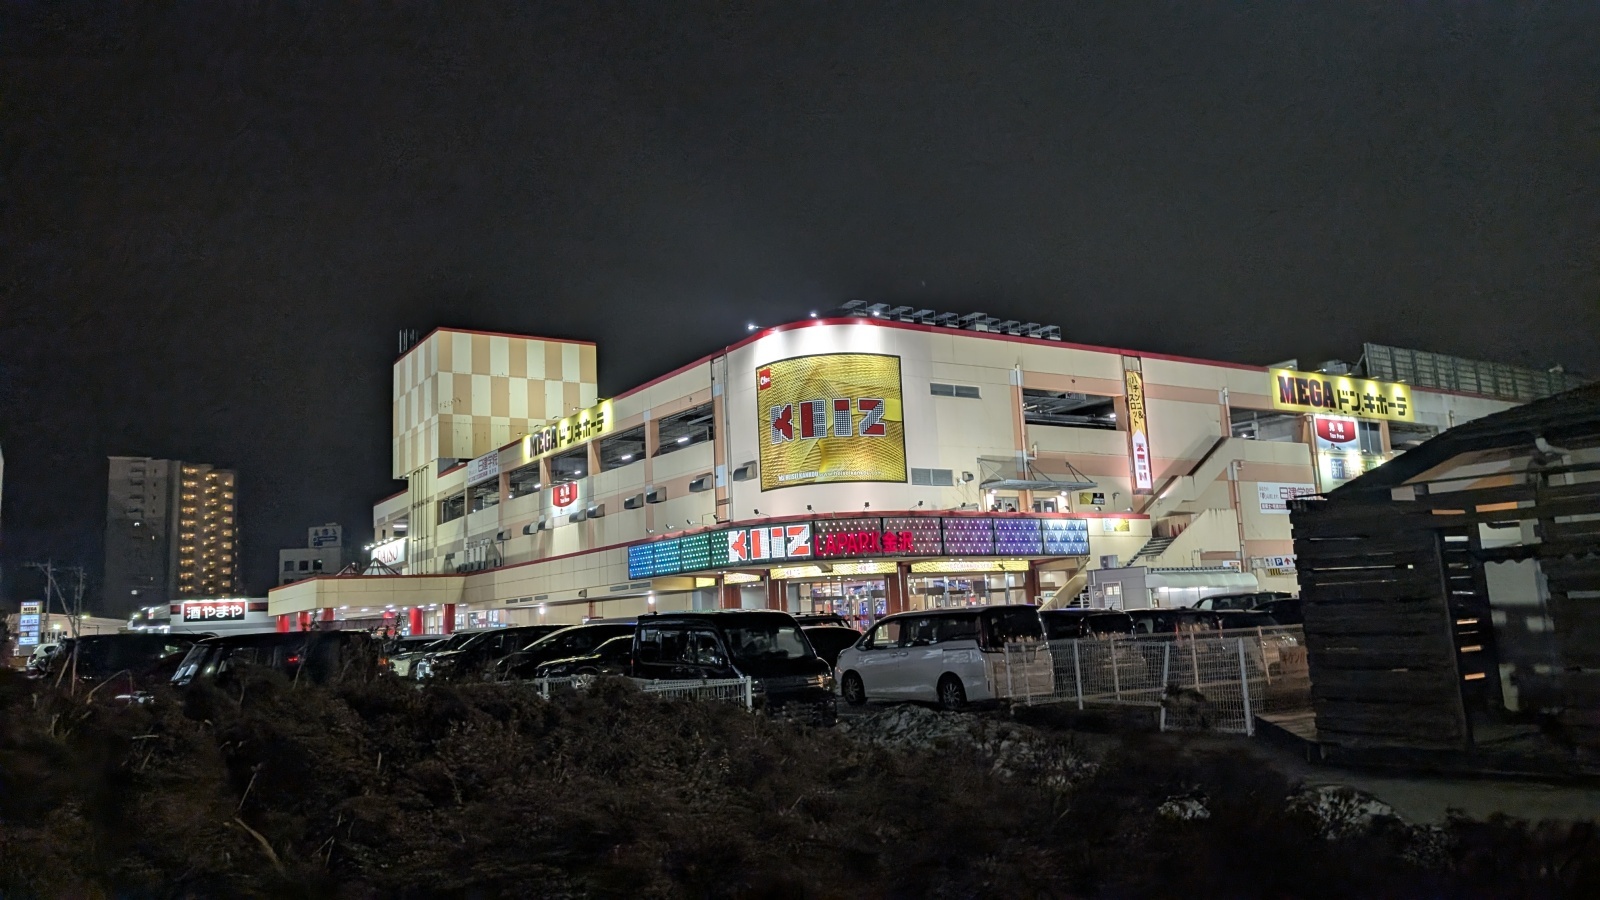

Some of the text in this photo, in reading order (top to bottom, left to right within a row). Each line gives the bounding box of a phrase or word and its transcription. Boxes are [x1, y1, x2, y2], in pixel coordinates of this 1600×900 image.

[1278, 376, 1336, 409] MEGA
[529, 426, 558, 458] MEGA
[814, 531, 882, 557] LAPARK
[882, 530, 914, 552] 金沢
